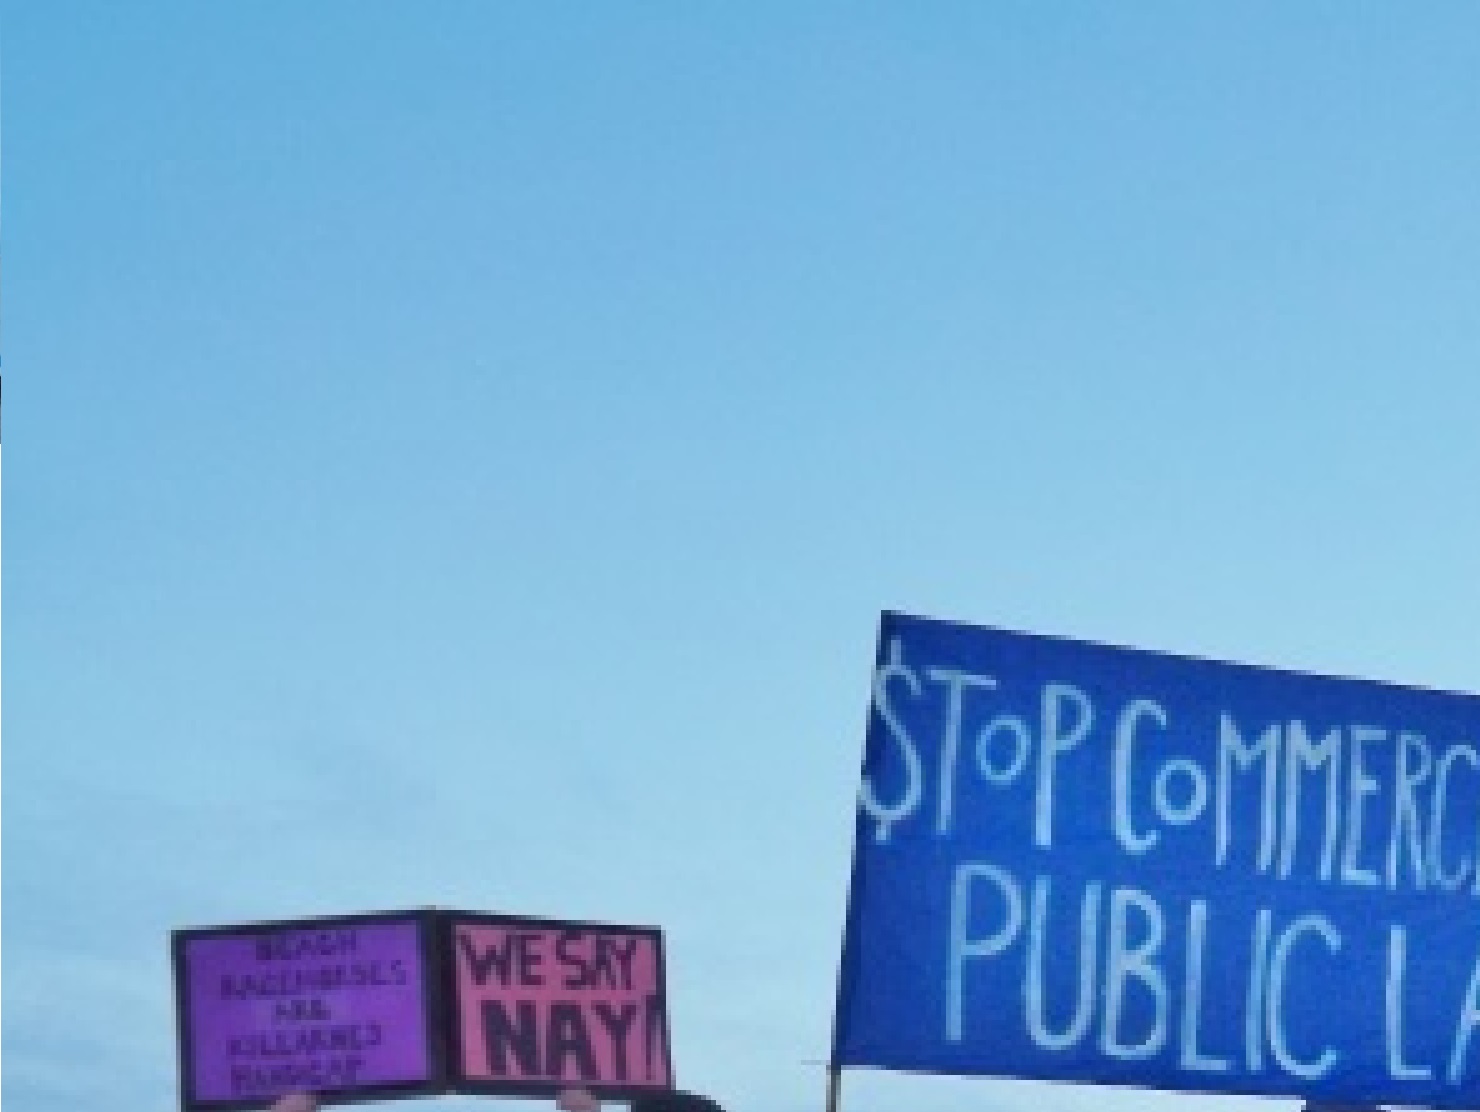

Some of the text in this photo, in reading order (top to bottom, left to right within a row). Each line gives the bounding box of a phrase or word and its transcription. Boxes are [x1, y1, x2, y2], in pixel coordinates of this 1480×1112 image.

[457, 933, 638, 991] WE SAY
[944, 860, 1342, 1081] PUBLIC
